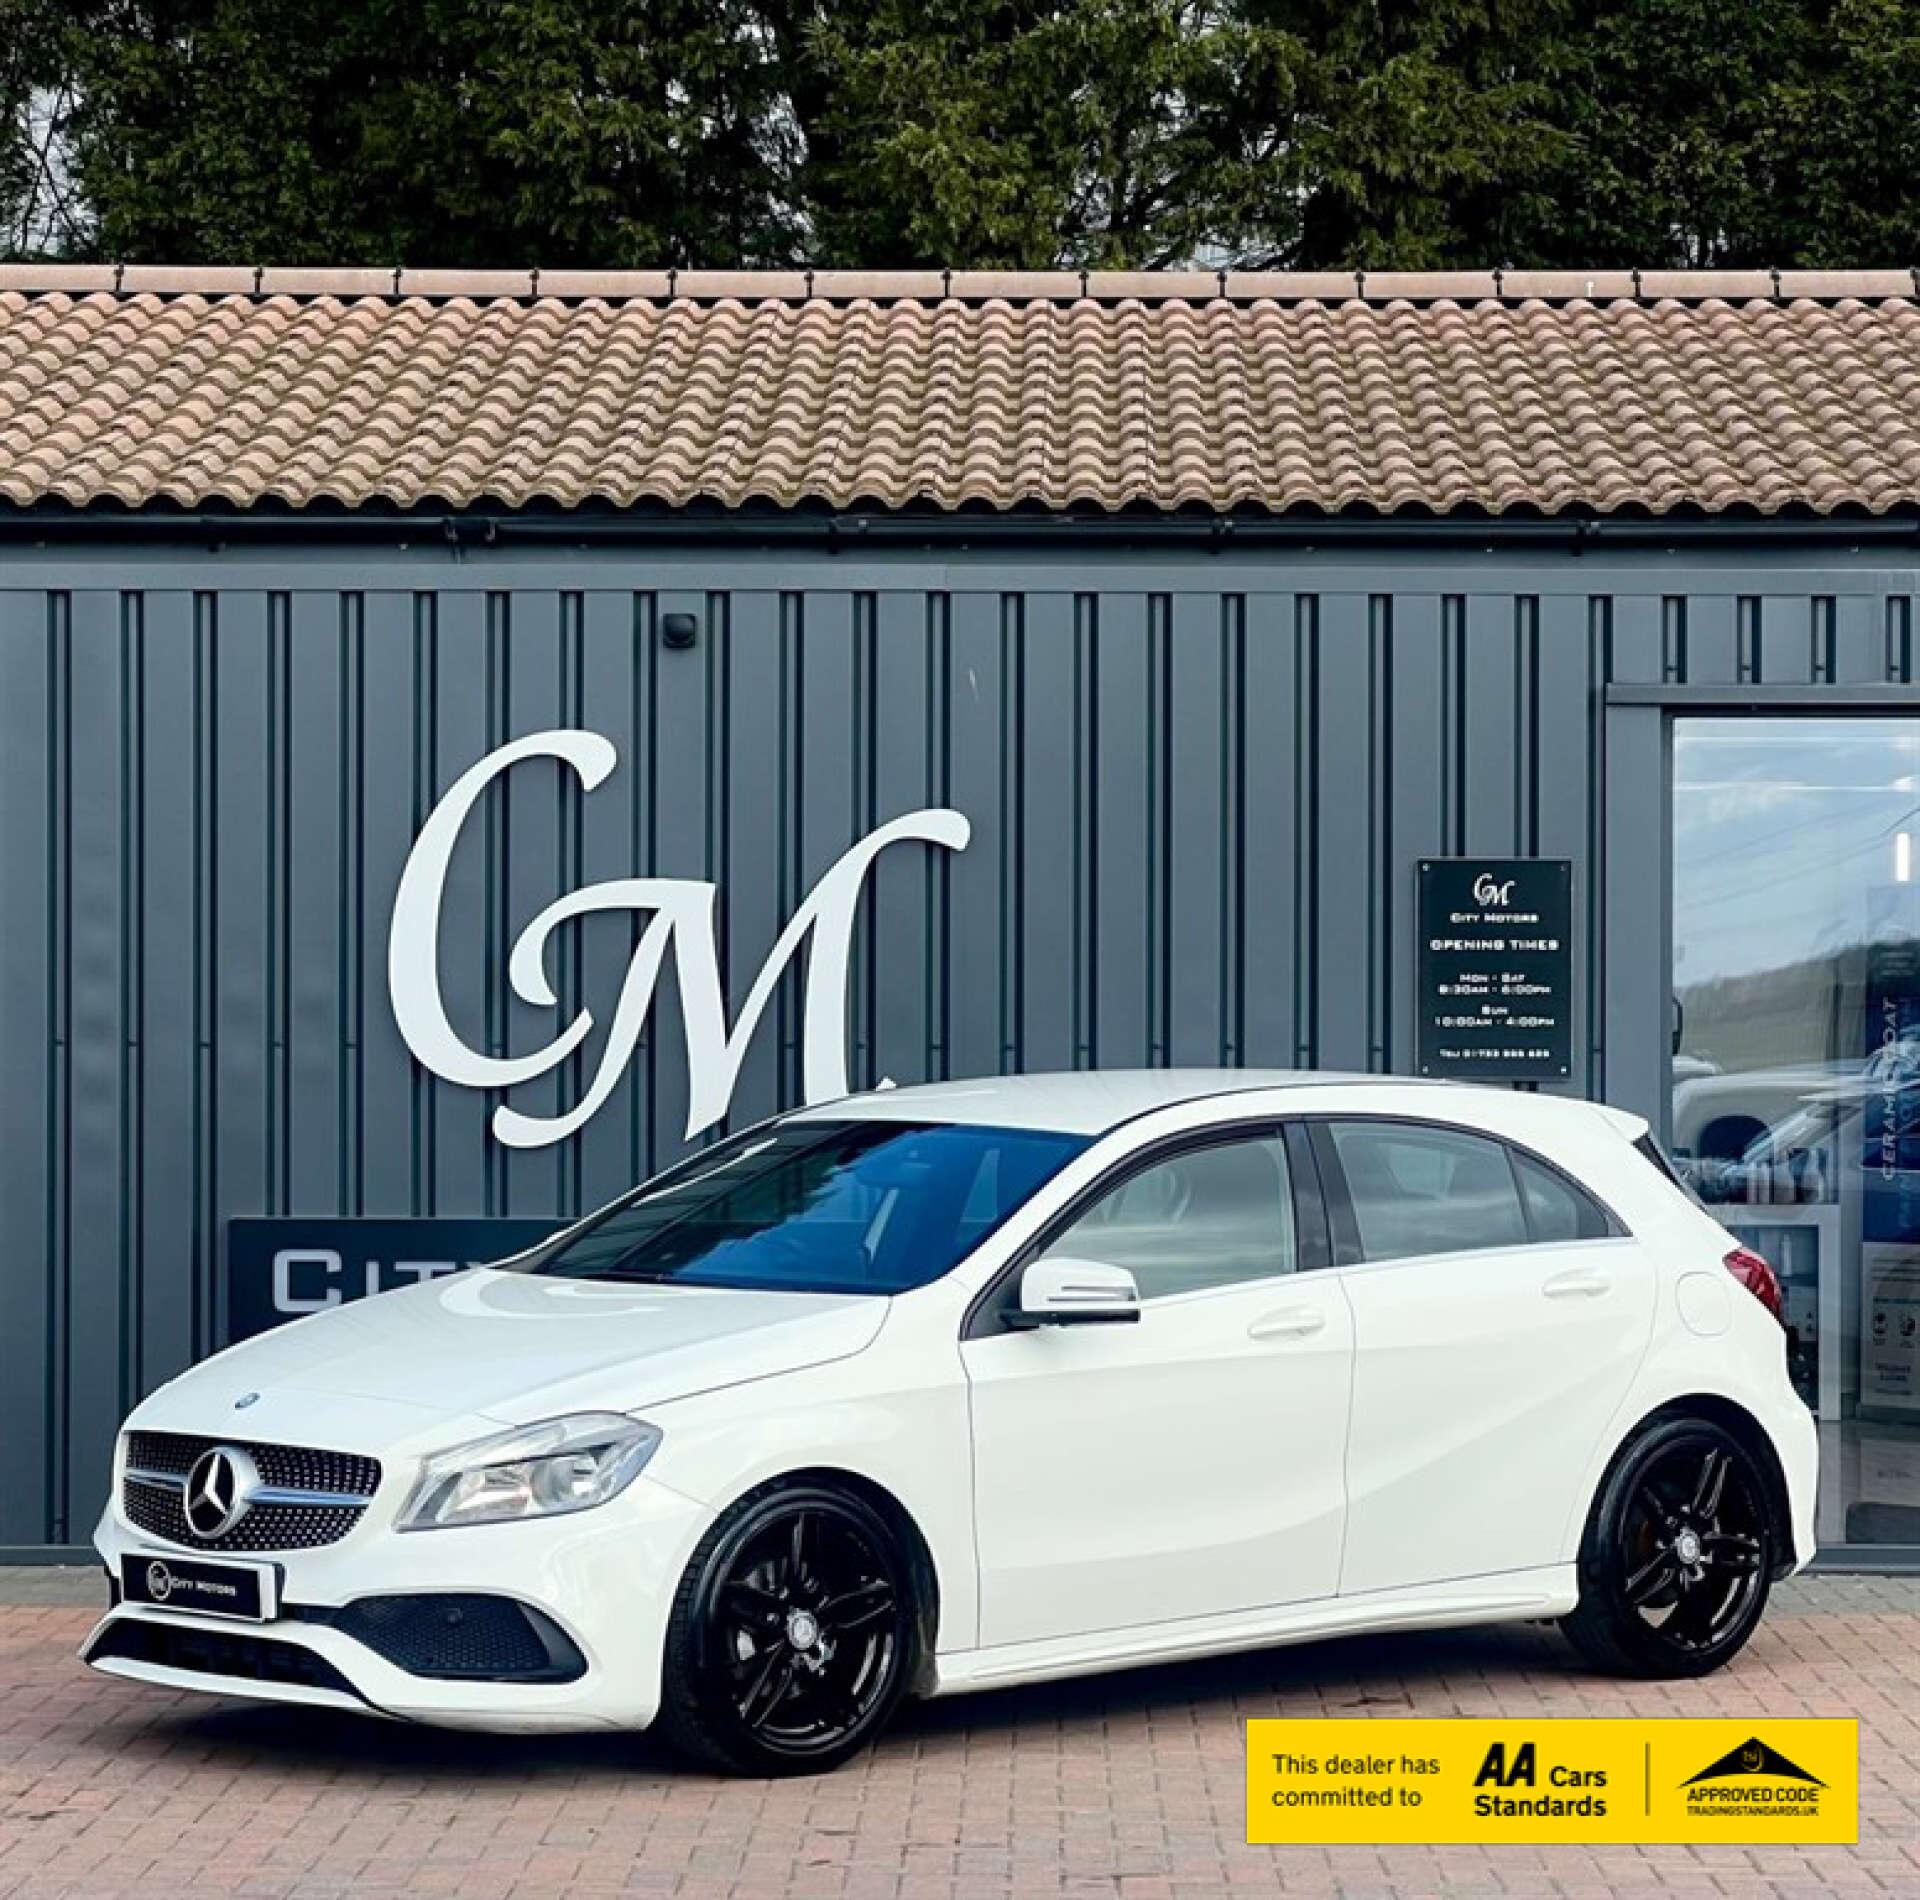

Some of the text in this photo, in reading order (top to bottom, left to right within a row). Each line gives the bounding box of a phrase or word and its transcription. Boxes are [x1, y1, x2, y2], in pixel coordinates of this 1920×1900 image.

[1430, 939, 1559, 951] OPENING TIMES
[273, 1249, 482, 1312] CIT
